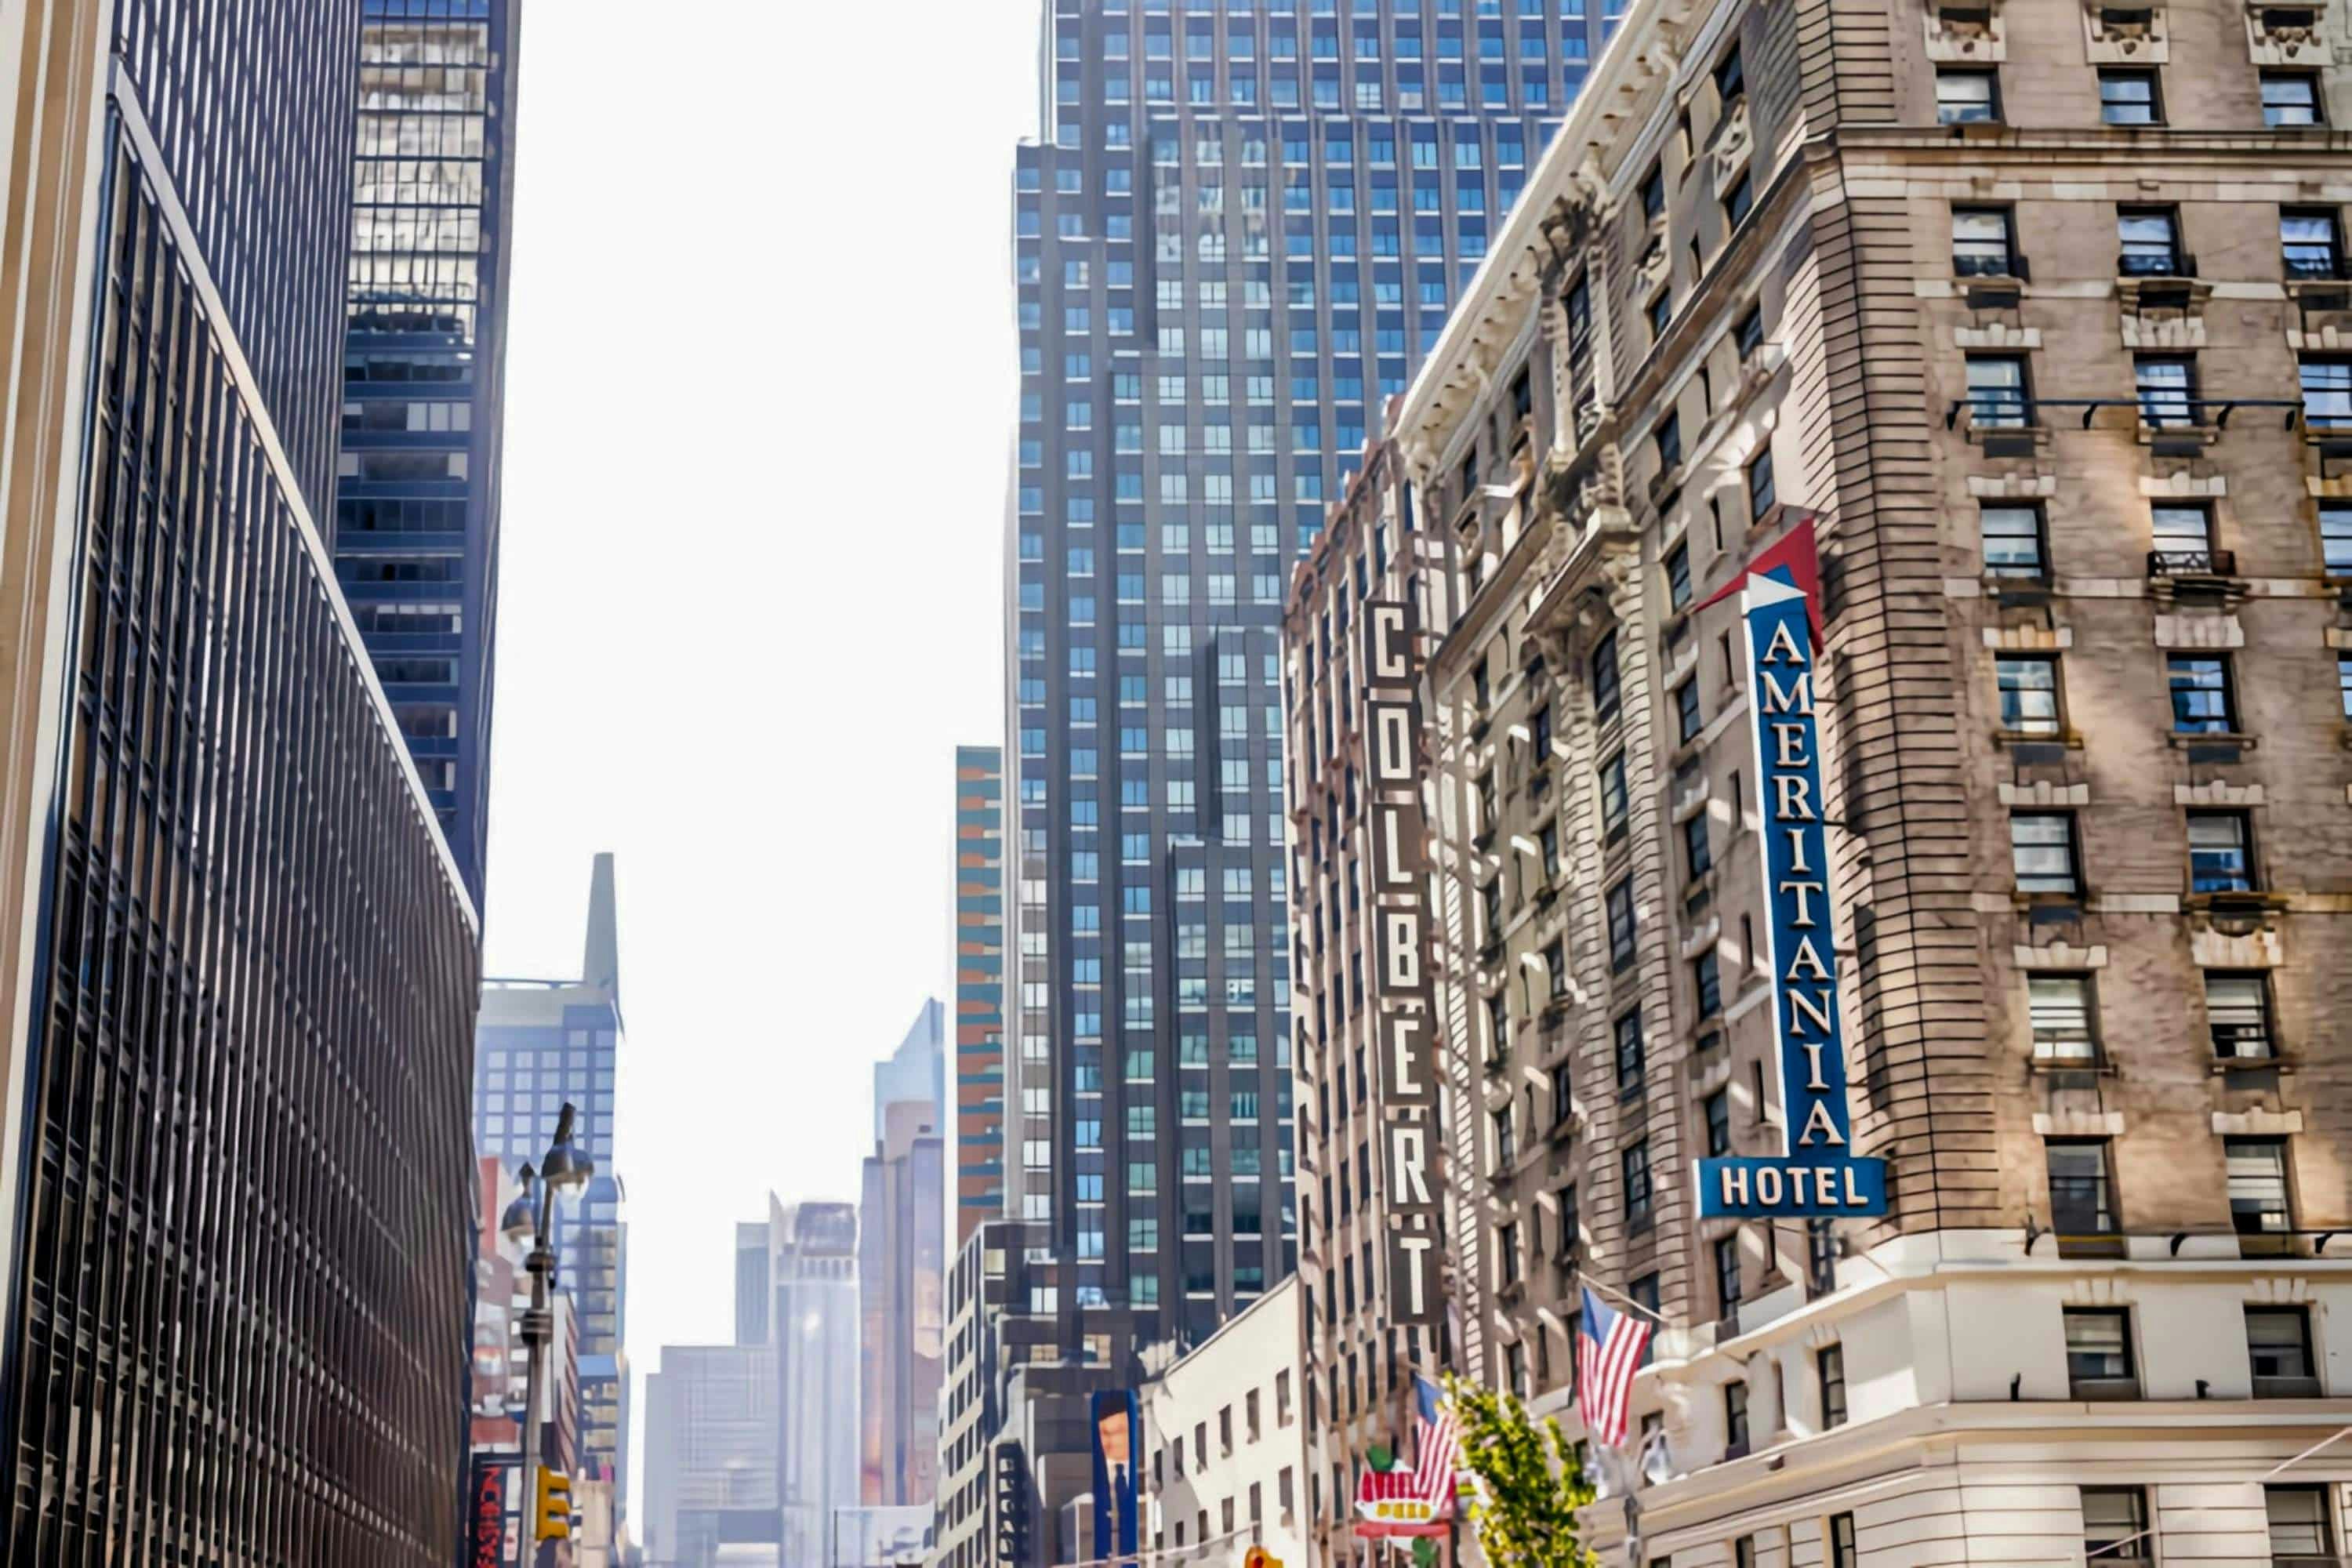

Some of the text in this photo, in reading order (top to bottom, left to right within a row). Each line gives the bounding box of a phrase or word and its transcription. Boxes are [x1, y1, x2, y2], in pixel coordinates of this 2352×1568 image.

[1374, 606, 1432, 1315] COLBERT
[1761, 619, 1847, 1146] AMERITANIA
[1721, 1166, 1870, 1206] HOTEL
